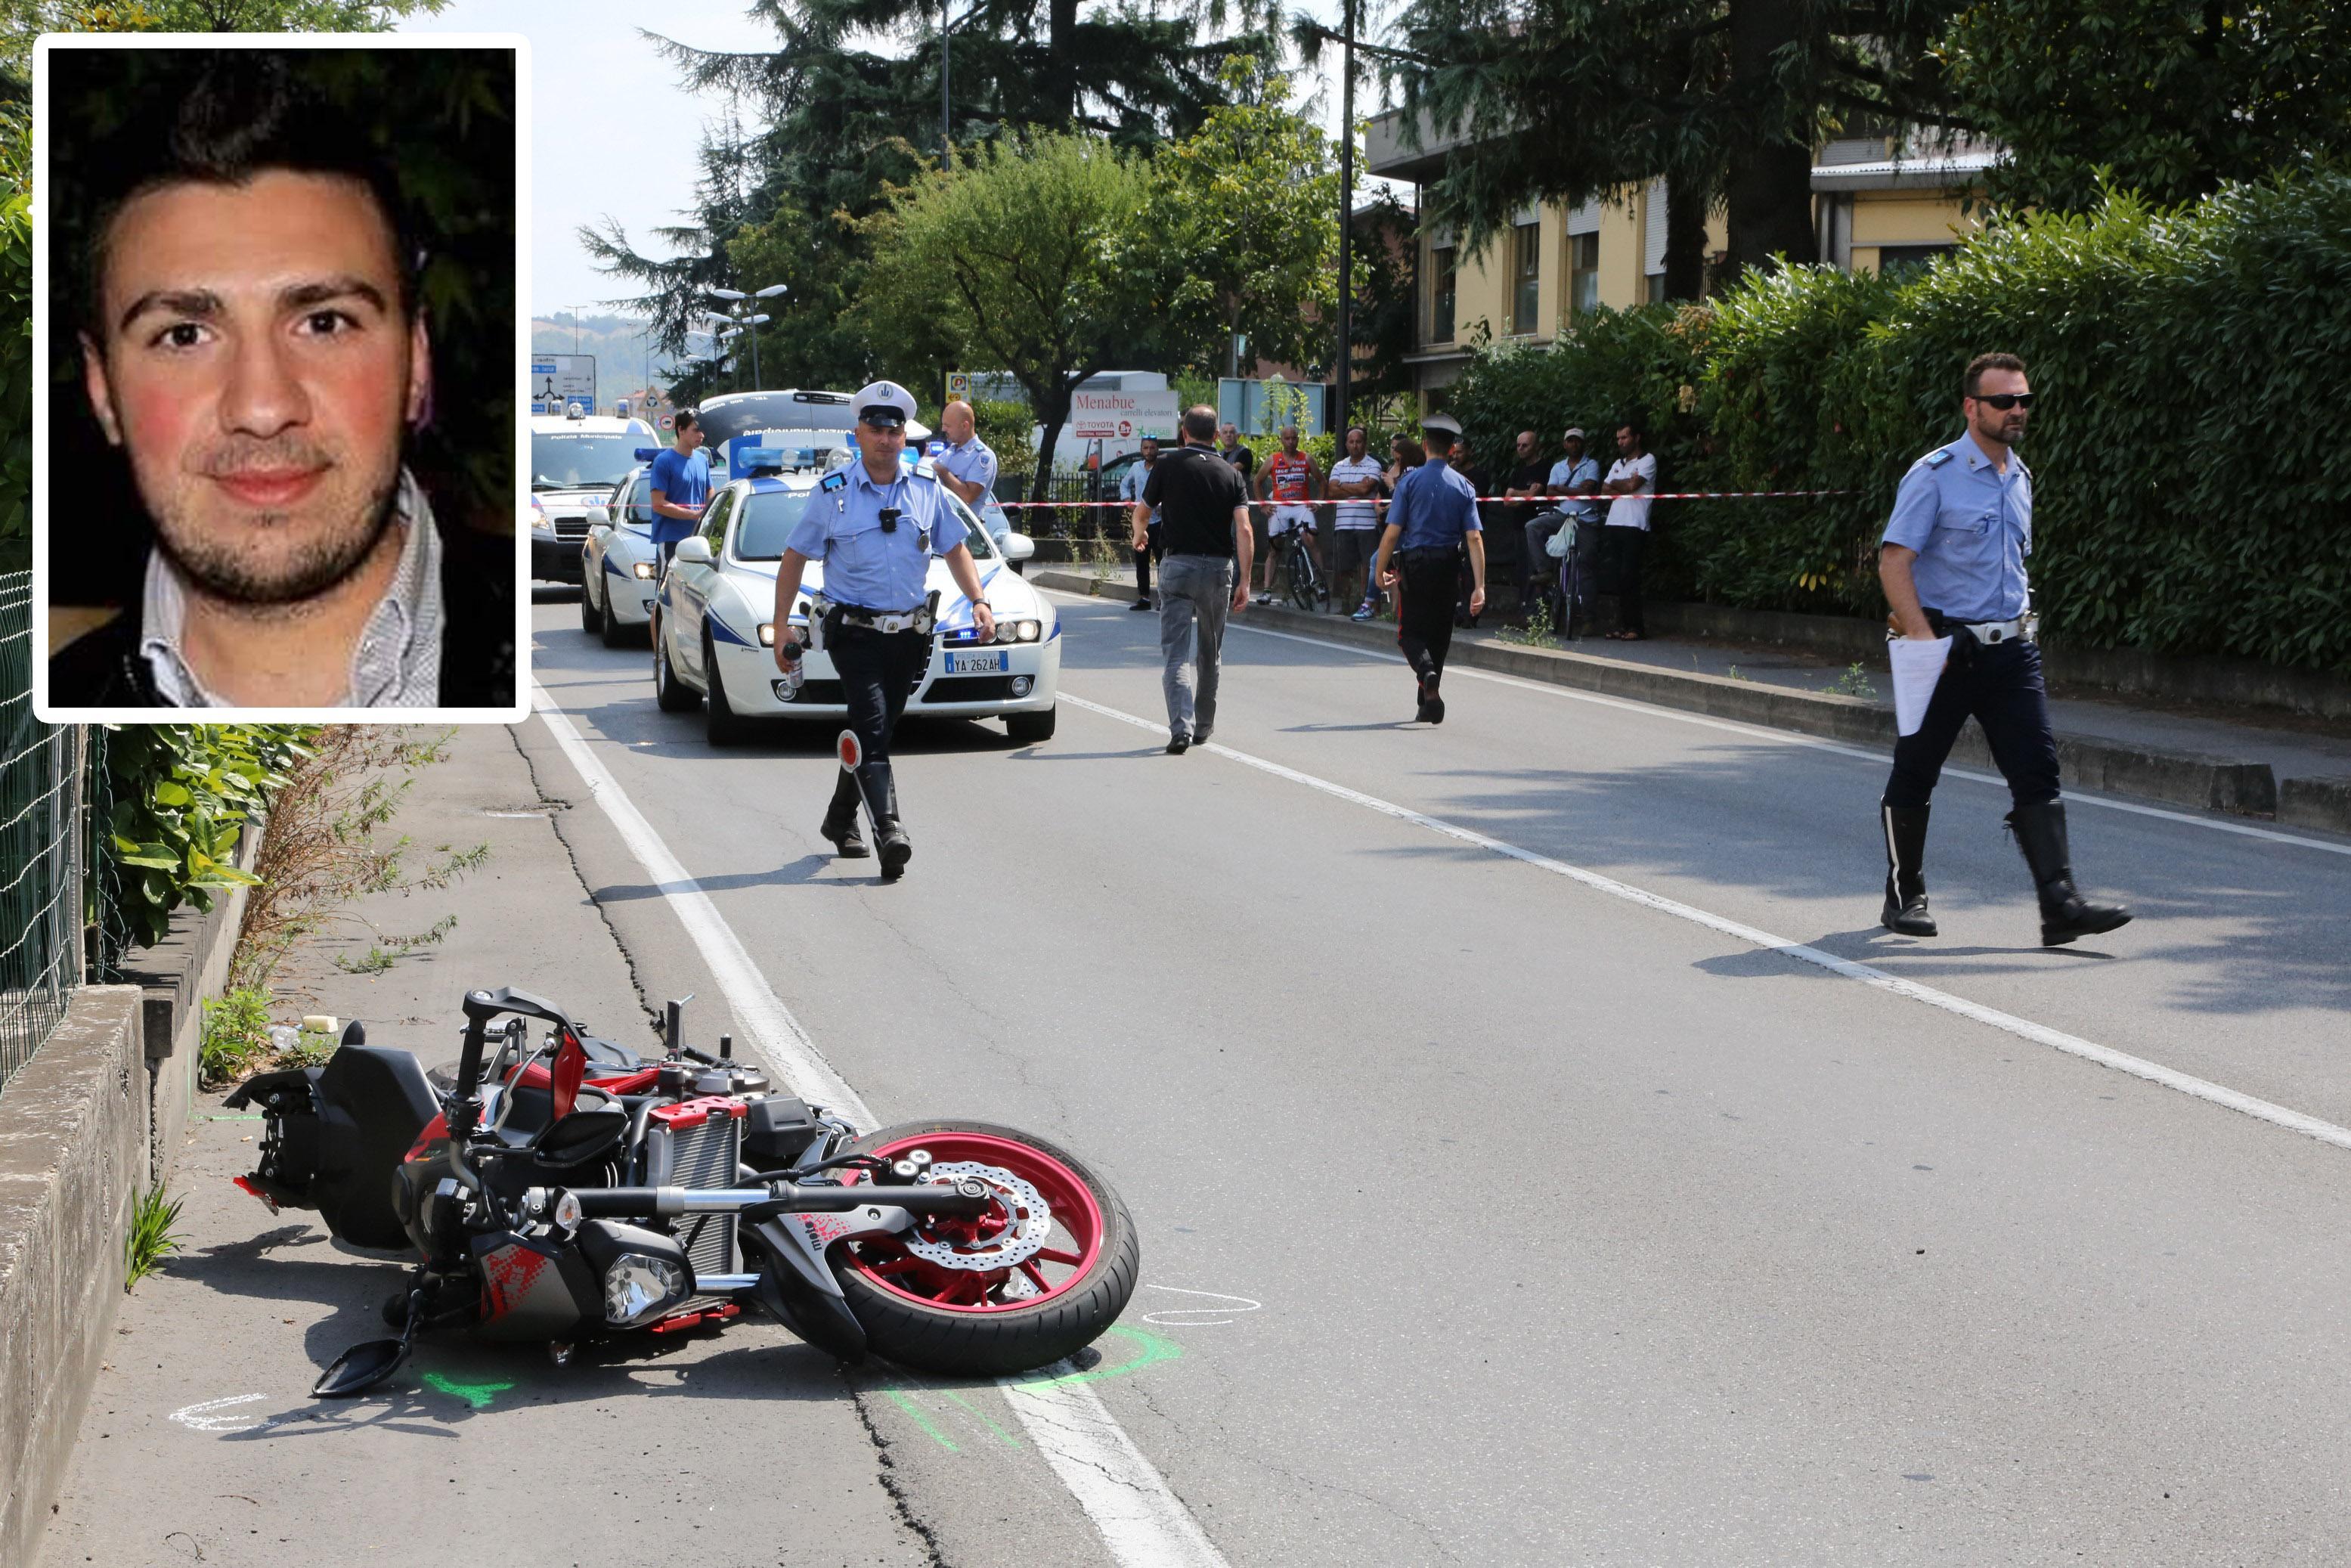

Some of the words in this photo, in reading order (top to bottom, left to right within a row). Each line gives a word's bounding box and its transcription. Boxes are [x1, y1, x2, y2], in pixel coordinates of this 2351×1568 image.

[1076, 394, 1135, 409] Menabue
[1120, 408, 1143, 417] carrelli
[955, 659, 967, 671] YA
